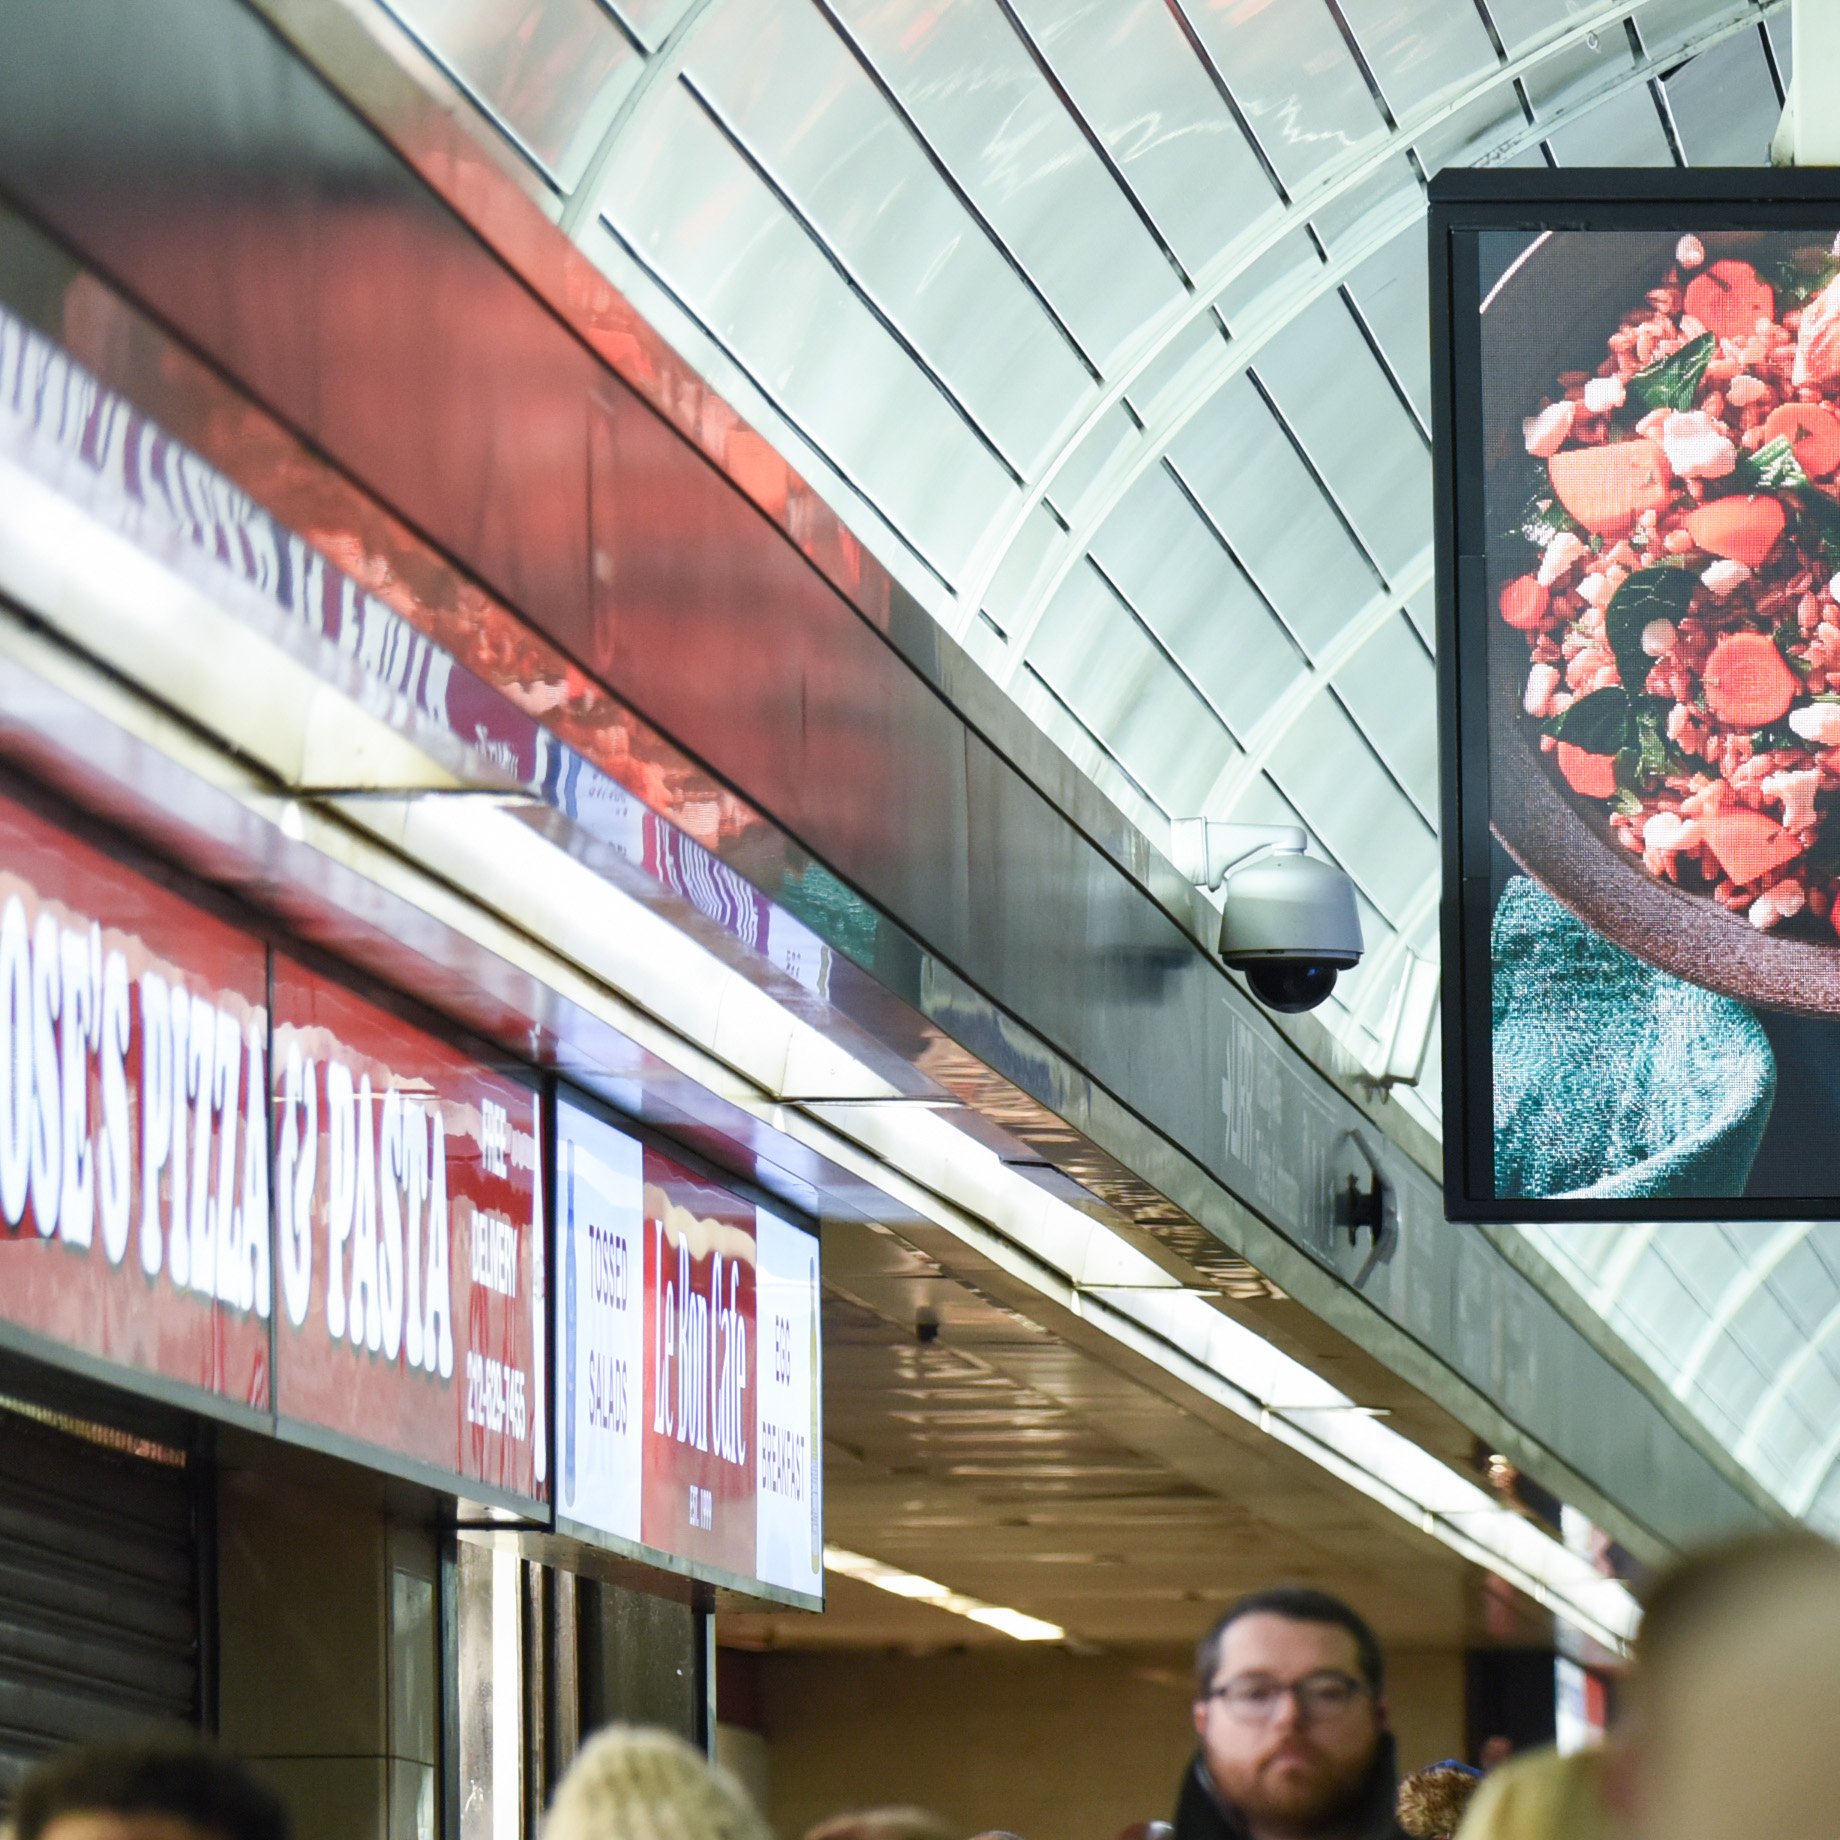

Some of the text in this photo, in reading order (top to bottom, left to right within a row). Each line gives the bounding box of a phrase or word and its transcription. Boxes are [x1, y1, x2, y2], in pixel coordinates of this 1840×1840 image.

[140, 969, 270, 1319] PIZZA
[326, 1060, 455, 1379] PASTA
[481, 1097, 508, 1180] FREE
[471, 1209, 519, 1299] DELIVERY
[588, 1225, 629, 1312] TOSSED
[653, 1219, 747, 1467] Le Bon Cafe
[774, 1315, 791, 1387] EGG
[588, 1349, 629, 1437] SALADS
[762, 1421, 805, 1503] BREAKFAST
